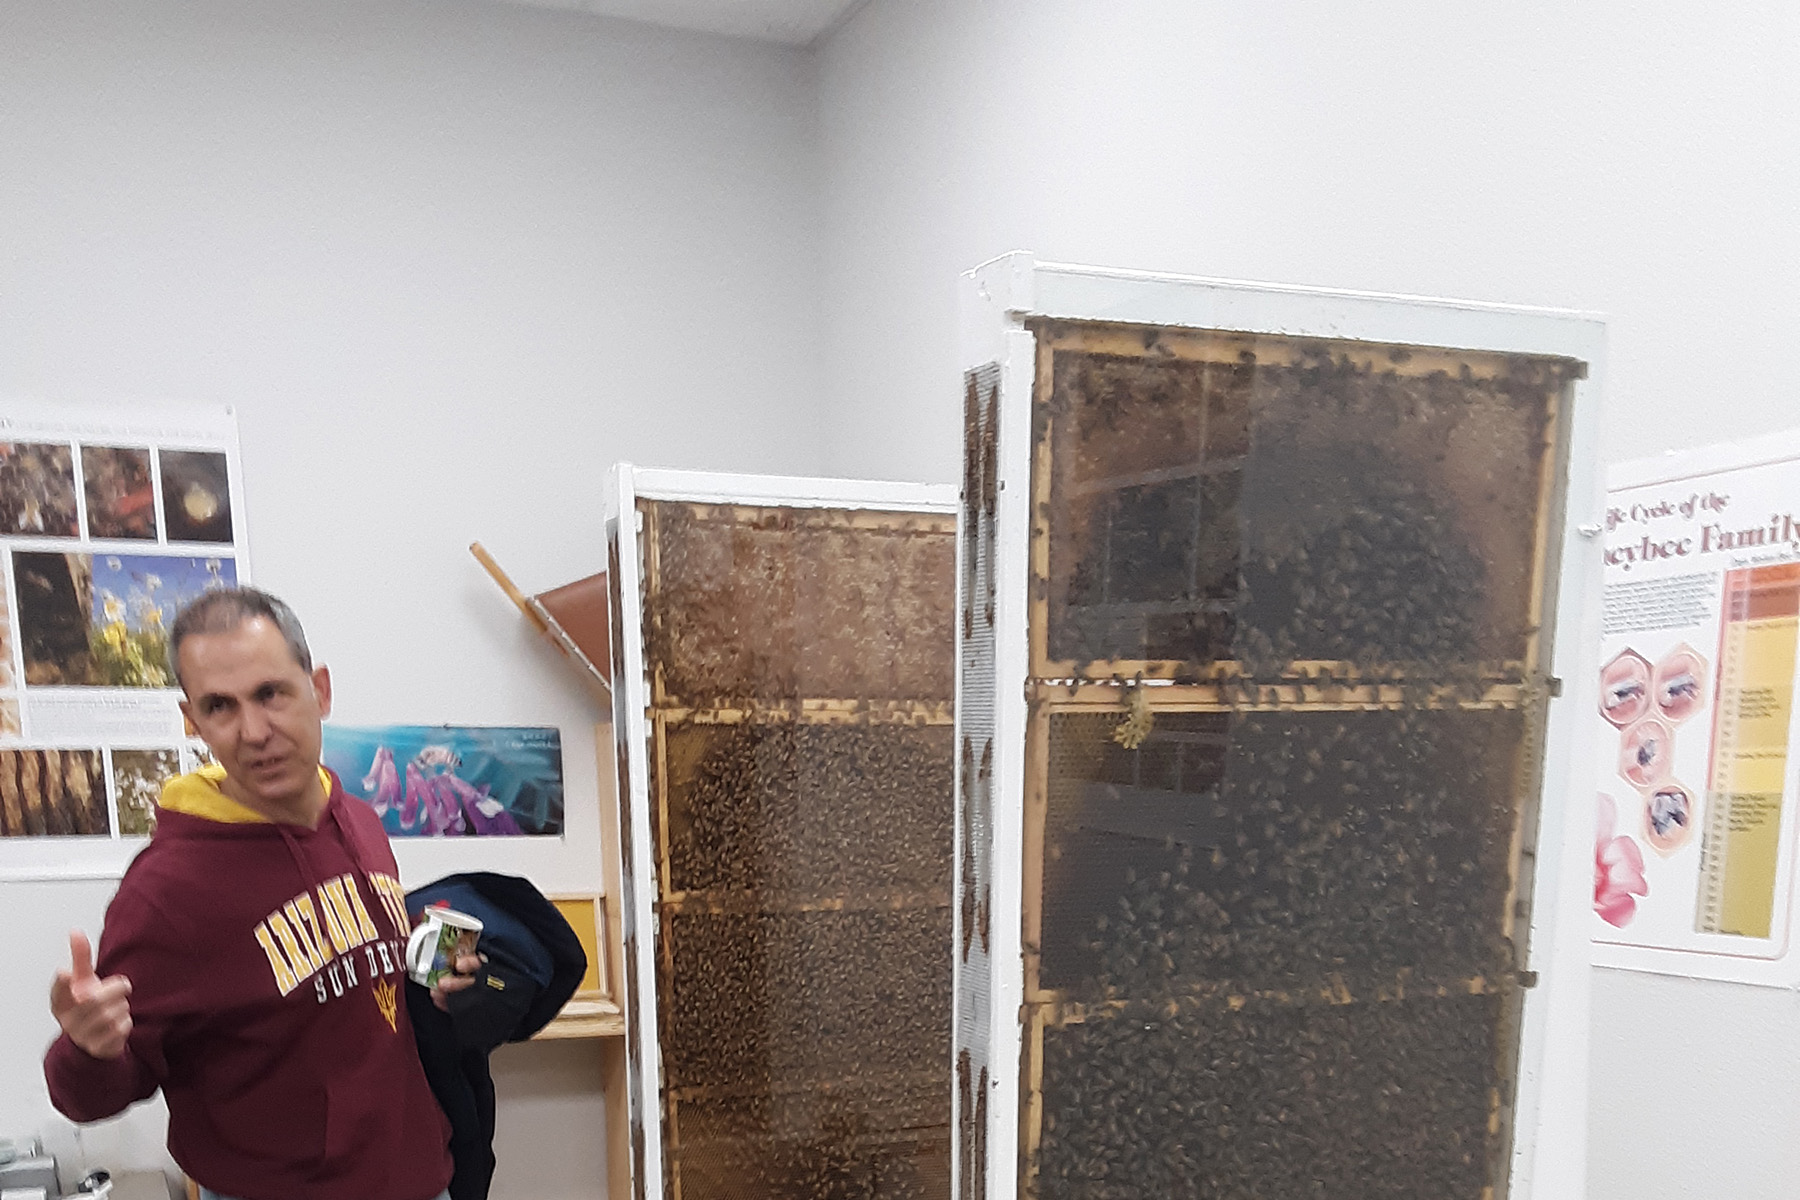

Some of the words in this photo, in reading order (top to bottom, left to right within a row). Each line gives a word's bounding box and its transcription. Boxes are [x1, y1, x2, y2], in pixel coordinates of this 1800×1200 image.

[1631, 501, 1676, 525] Cycle
[1679, 494, 1699, 519] of
[1701, 492, 1731, 513] the
[253, 872, 379, 997] ARIZONA
[314, 953, 359, 1004] SUN
